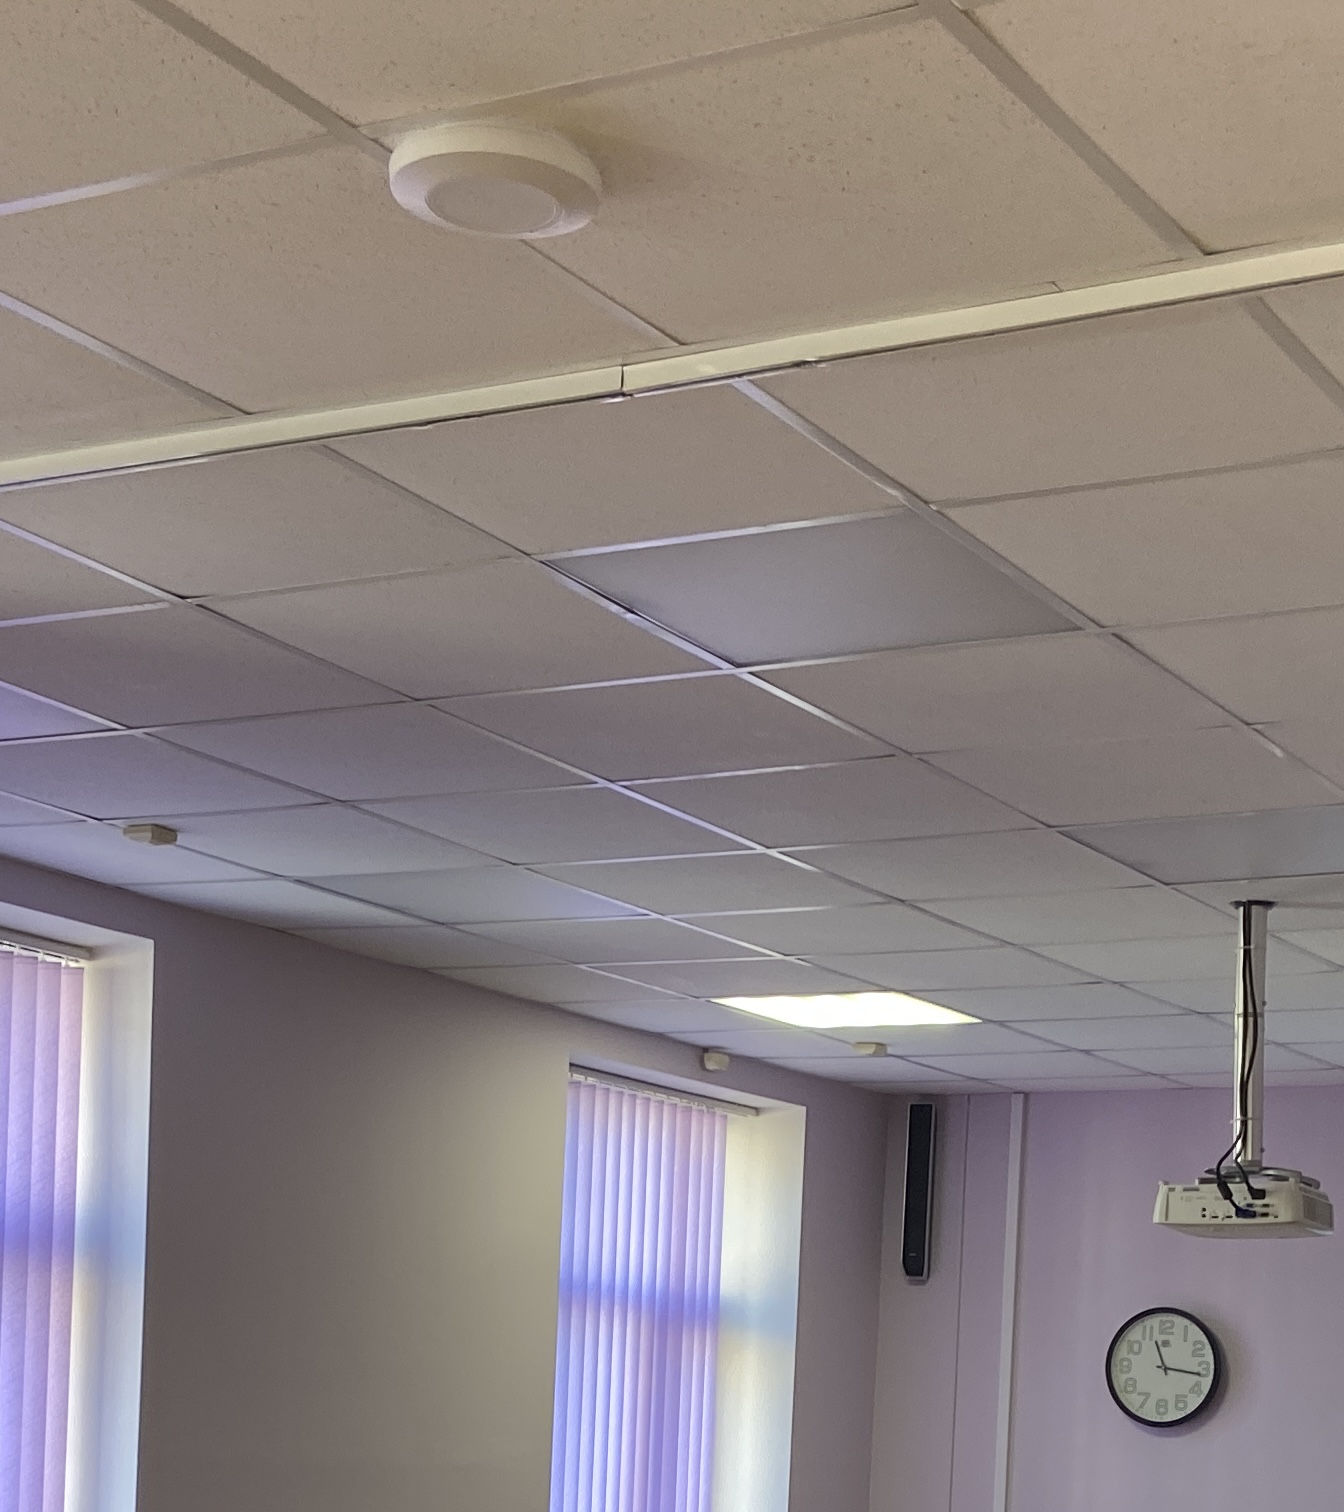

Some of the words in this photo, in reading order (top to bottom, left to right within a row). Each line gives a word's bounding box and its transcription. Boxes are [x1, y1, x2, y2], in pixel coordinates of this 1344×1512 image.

[1142, 1325, 1154, 1341] 11
[1159, 1319, 1175, 1336] 12
[1183, 1325, 1188, 1342] 1
[1127, 1340, 1142, 1355] 10
[1192, 1341, 1205, 1357] 2
[1119, 1358, 1132, 1374] 9
[1198, 1361, 1211, 1378] 3
[1124, 1378, 1137, 1394] 8
[1189, 1381, 1203, 1397] 4
[1137, 1392, 1151, 1408] 7
[1155, 1399, 1169, 1416] 6
[1174, 1394, 1188, 1411] 5
